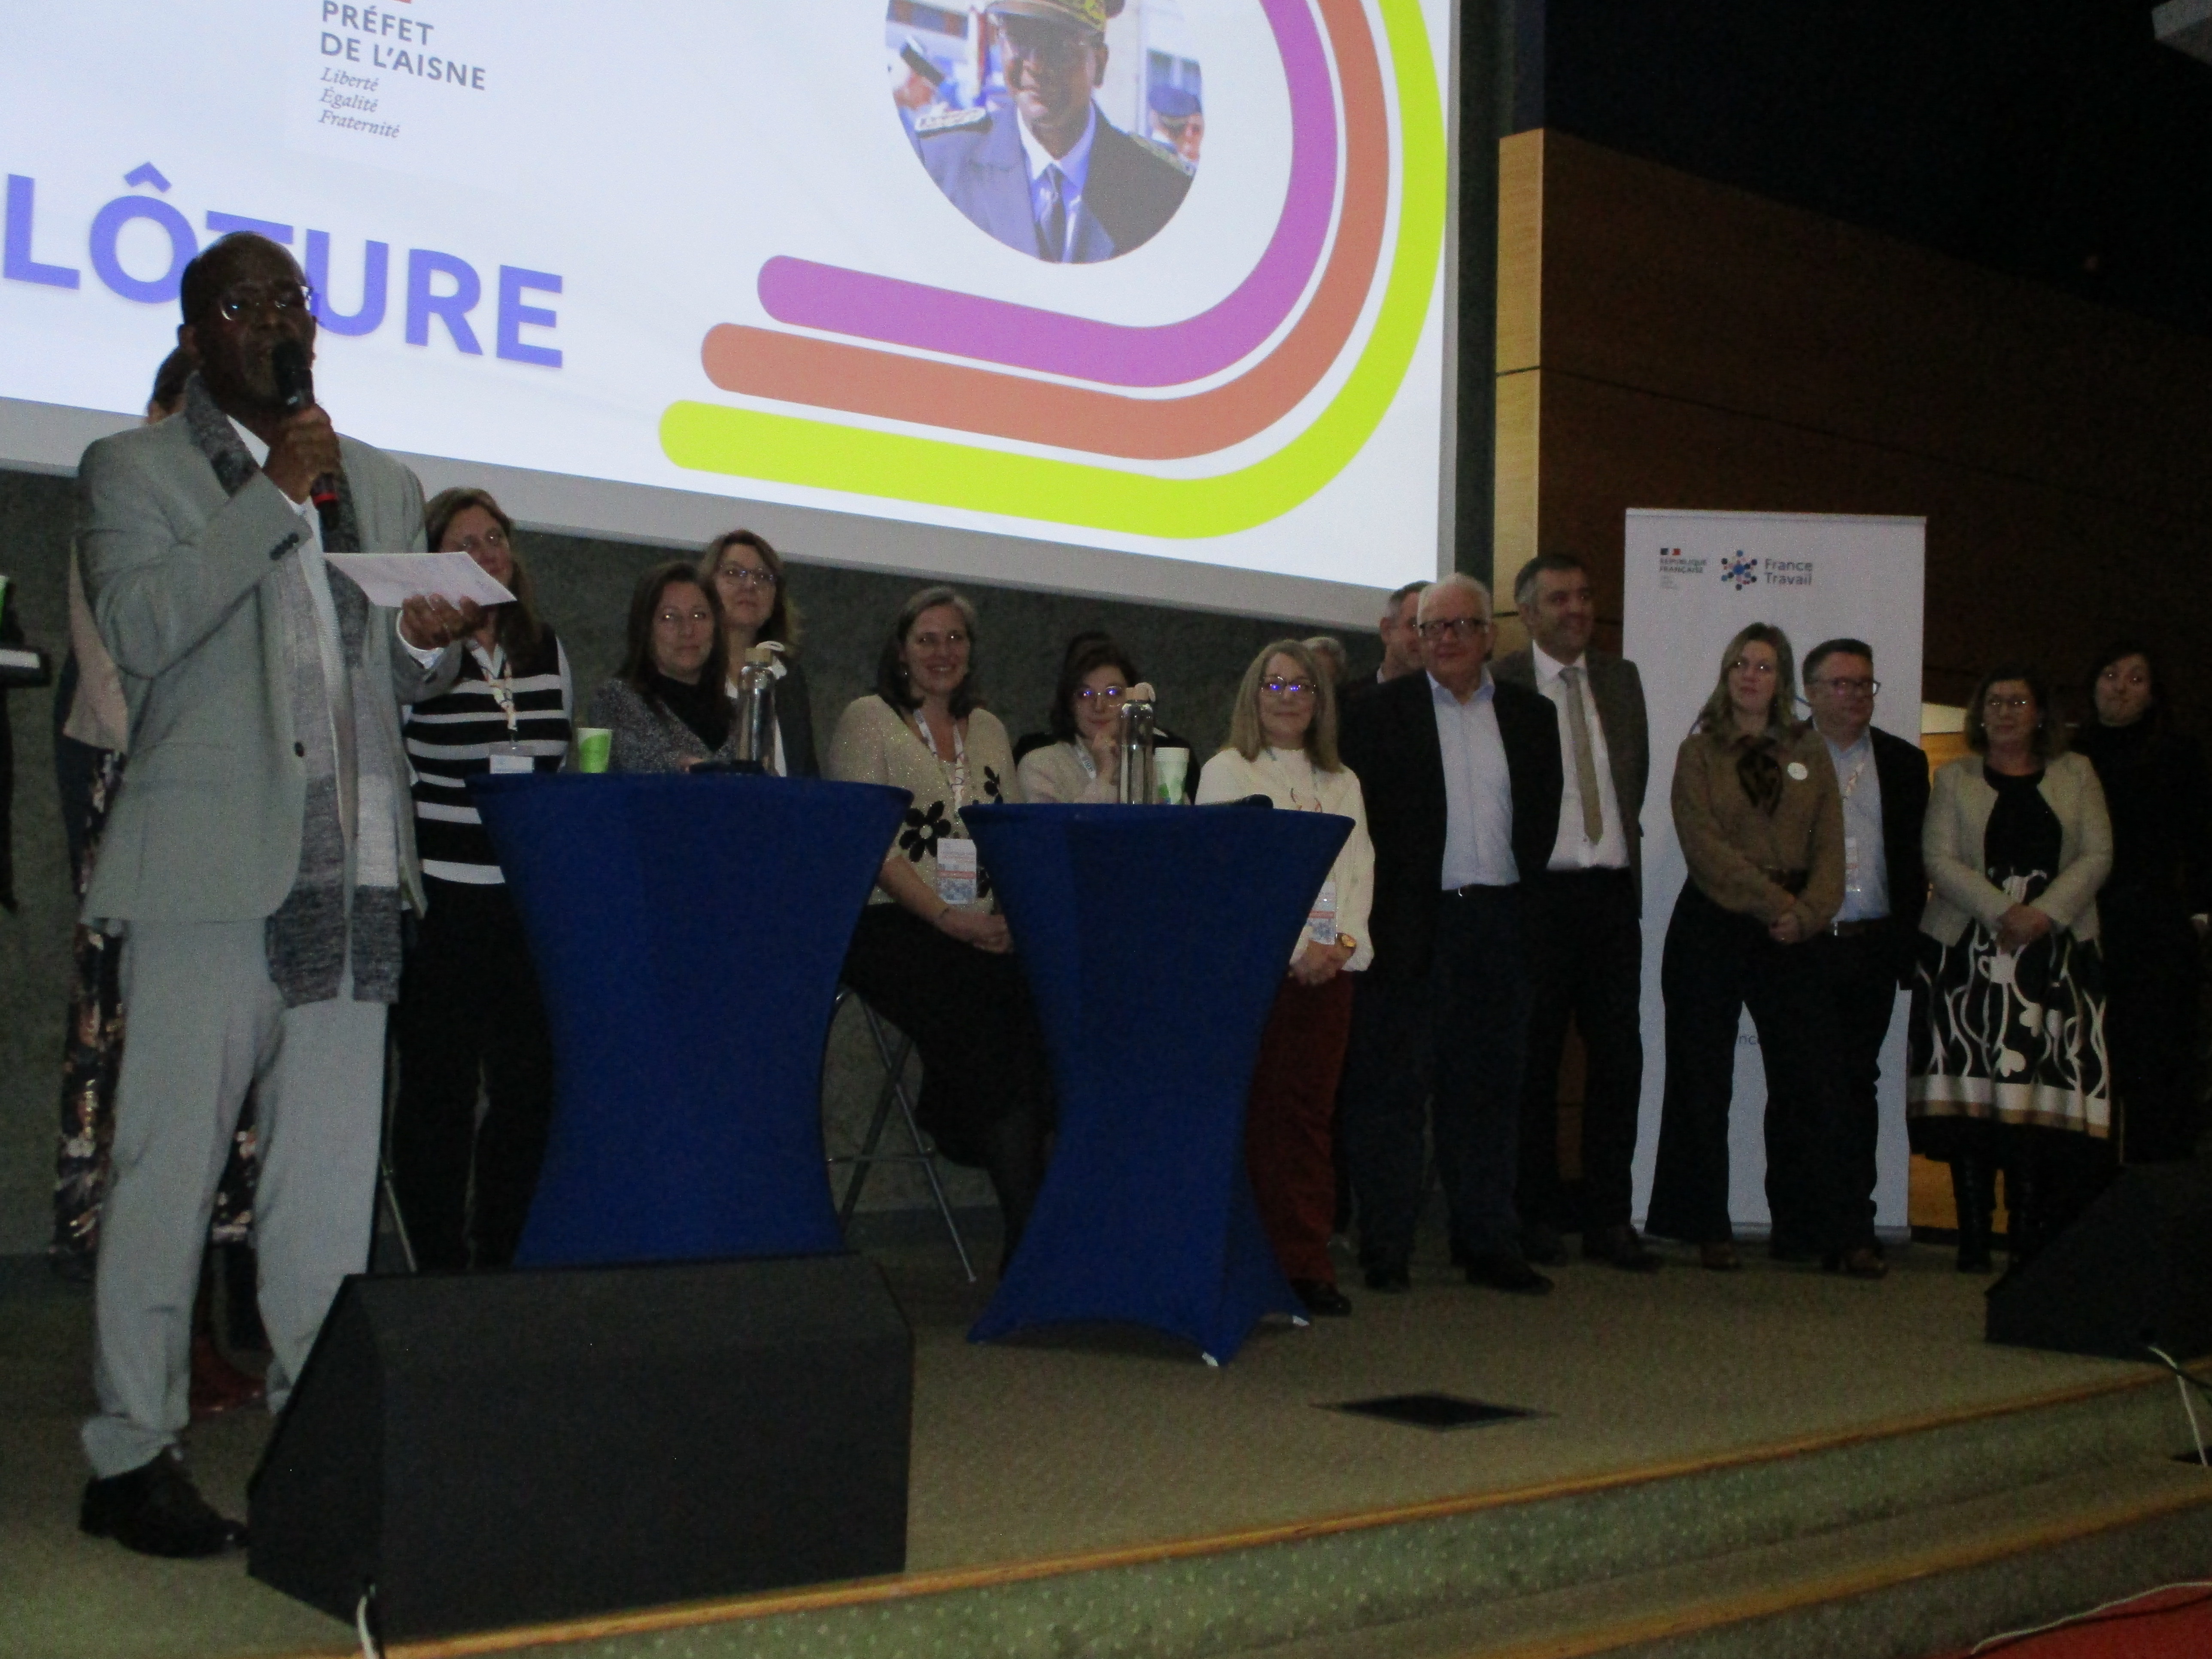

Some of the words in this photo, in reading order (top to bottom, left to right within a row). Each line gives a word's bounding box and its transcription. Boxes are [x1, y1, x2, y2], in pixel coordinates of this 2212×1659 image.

[322, 0, 434, 45] PRÉFET
[321, 32, 361, 62] DE
[373, 44, 486, 91] L'AISNE
[320, 67, 379, 92] Liberté
[319, 87, 378, 112] Égalité
[318, 109, 400, 138] Fraternité
[1765, 558, 1813, 571] France
[1765, 572, 1812, 585] Travail
